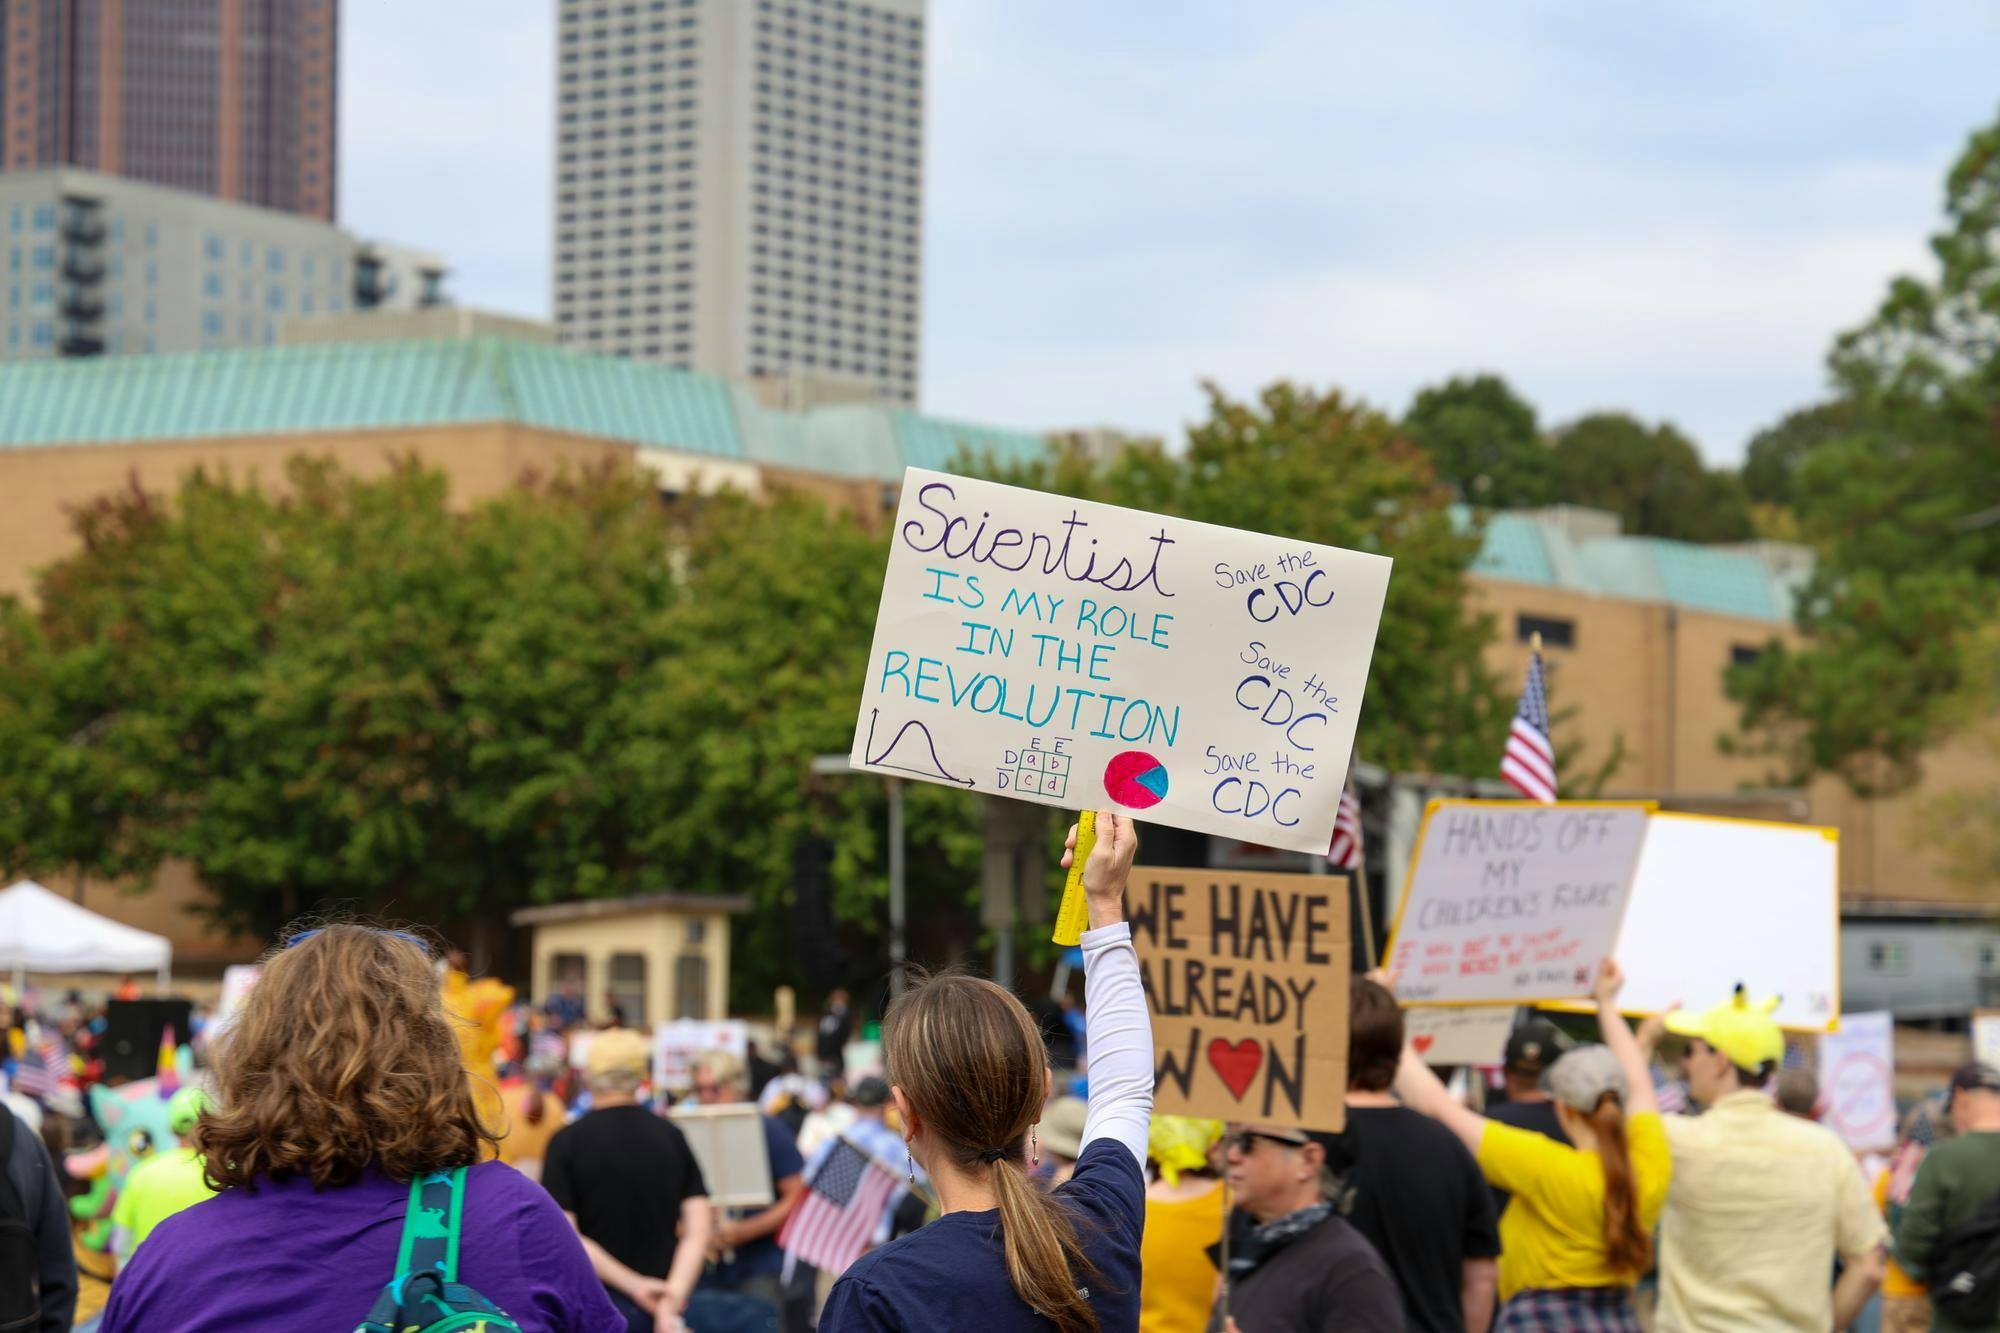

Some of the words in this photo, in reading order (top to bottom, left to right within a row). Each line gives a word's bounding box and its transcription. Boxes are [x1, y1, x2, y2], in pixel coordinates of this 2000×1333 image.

[903, 483, 1176, 597] Scientist
[1214, 562, 1270, 589] Save
[1277, 550, 1317, 573] the
[1247, 569, 1335, 623] CDC
[922, 567, 985, 608] IS
[1001, 588, 1064, 624] MY
[1077, 599, 1174, 649] ROLE
[955, 621, 1014, 658] IN
[1032, 634, 1116, 681] THE
[1239, 641, 1291, 679] Save
[1303, 673, 1338, 713] the
[881, 651, 1180, 747] REVOLUTION
[1235, 675, 1328, 751] CDC
[1051, 757, 1060, 769] b
[1203, 745, 1260, 775] Save
[1271, 751, 1316, 780] the
[1212, 776, 1301, 827] CDC
[1442, 811, 1548, 856] HANDS
[1557, 812, 1618, 853] OFF
[1480, 857, 1526, 889] MY
[1121, 882, 1187, 949] WE
[1210, 884, 1331, 965] HAVE
